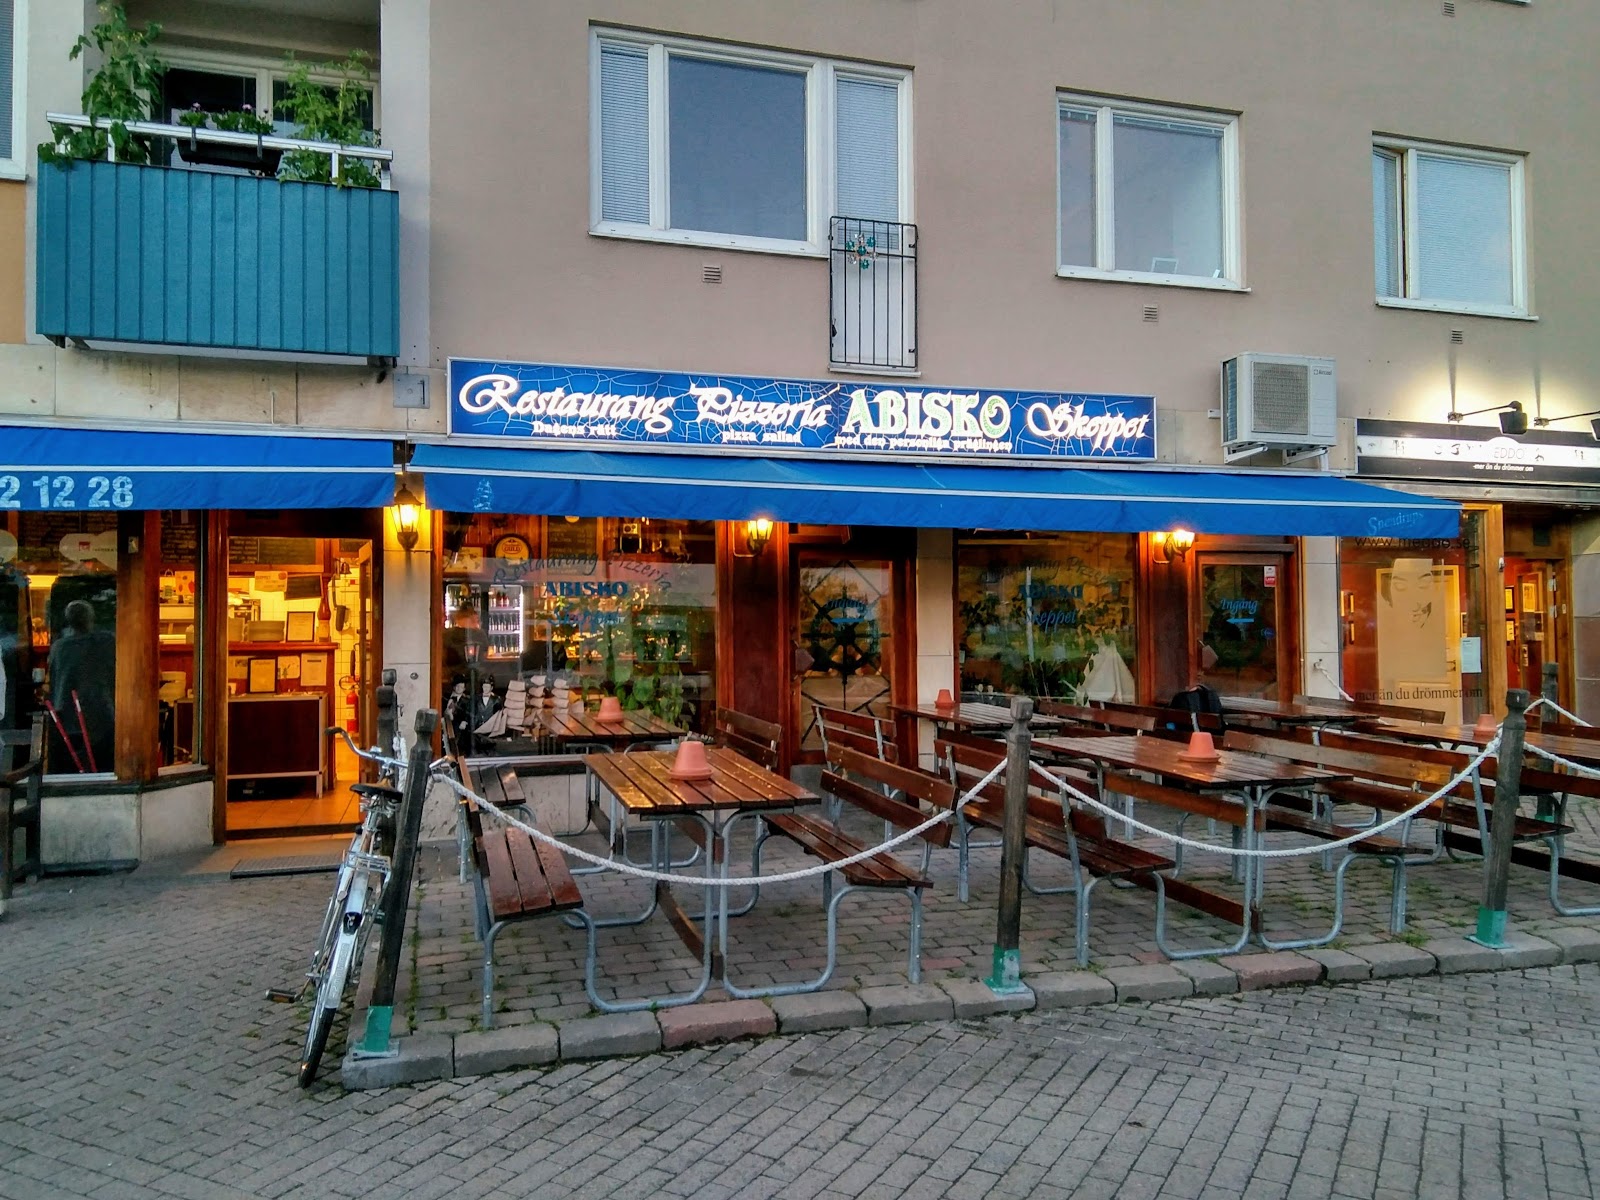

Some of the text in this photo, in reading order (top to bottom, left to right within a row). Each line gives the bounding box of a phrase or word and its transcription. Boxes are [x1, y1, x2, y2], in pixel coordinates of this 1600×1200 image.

[458, 374, 840, 433] Restaurang Pizzeria
[841, 388, 1012, 438] ABISKO
[1026, 401, 1151, 447] Skeppet
[722, 429, 802, 443] pizza sallad
[834, 434, 860, 446] med
[33, 476, 75, 507] 12
[88, 476, 134, 507] 28
[544, 581, 628, 597] ABISKO
[1220, 599, 1258, 614] Ingång
[1380, 689, 1393, 700] än
[1395, 688, 1410, 700] du
[1413, 686, 1462, 699] drömmer
